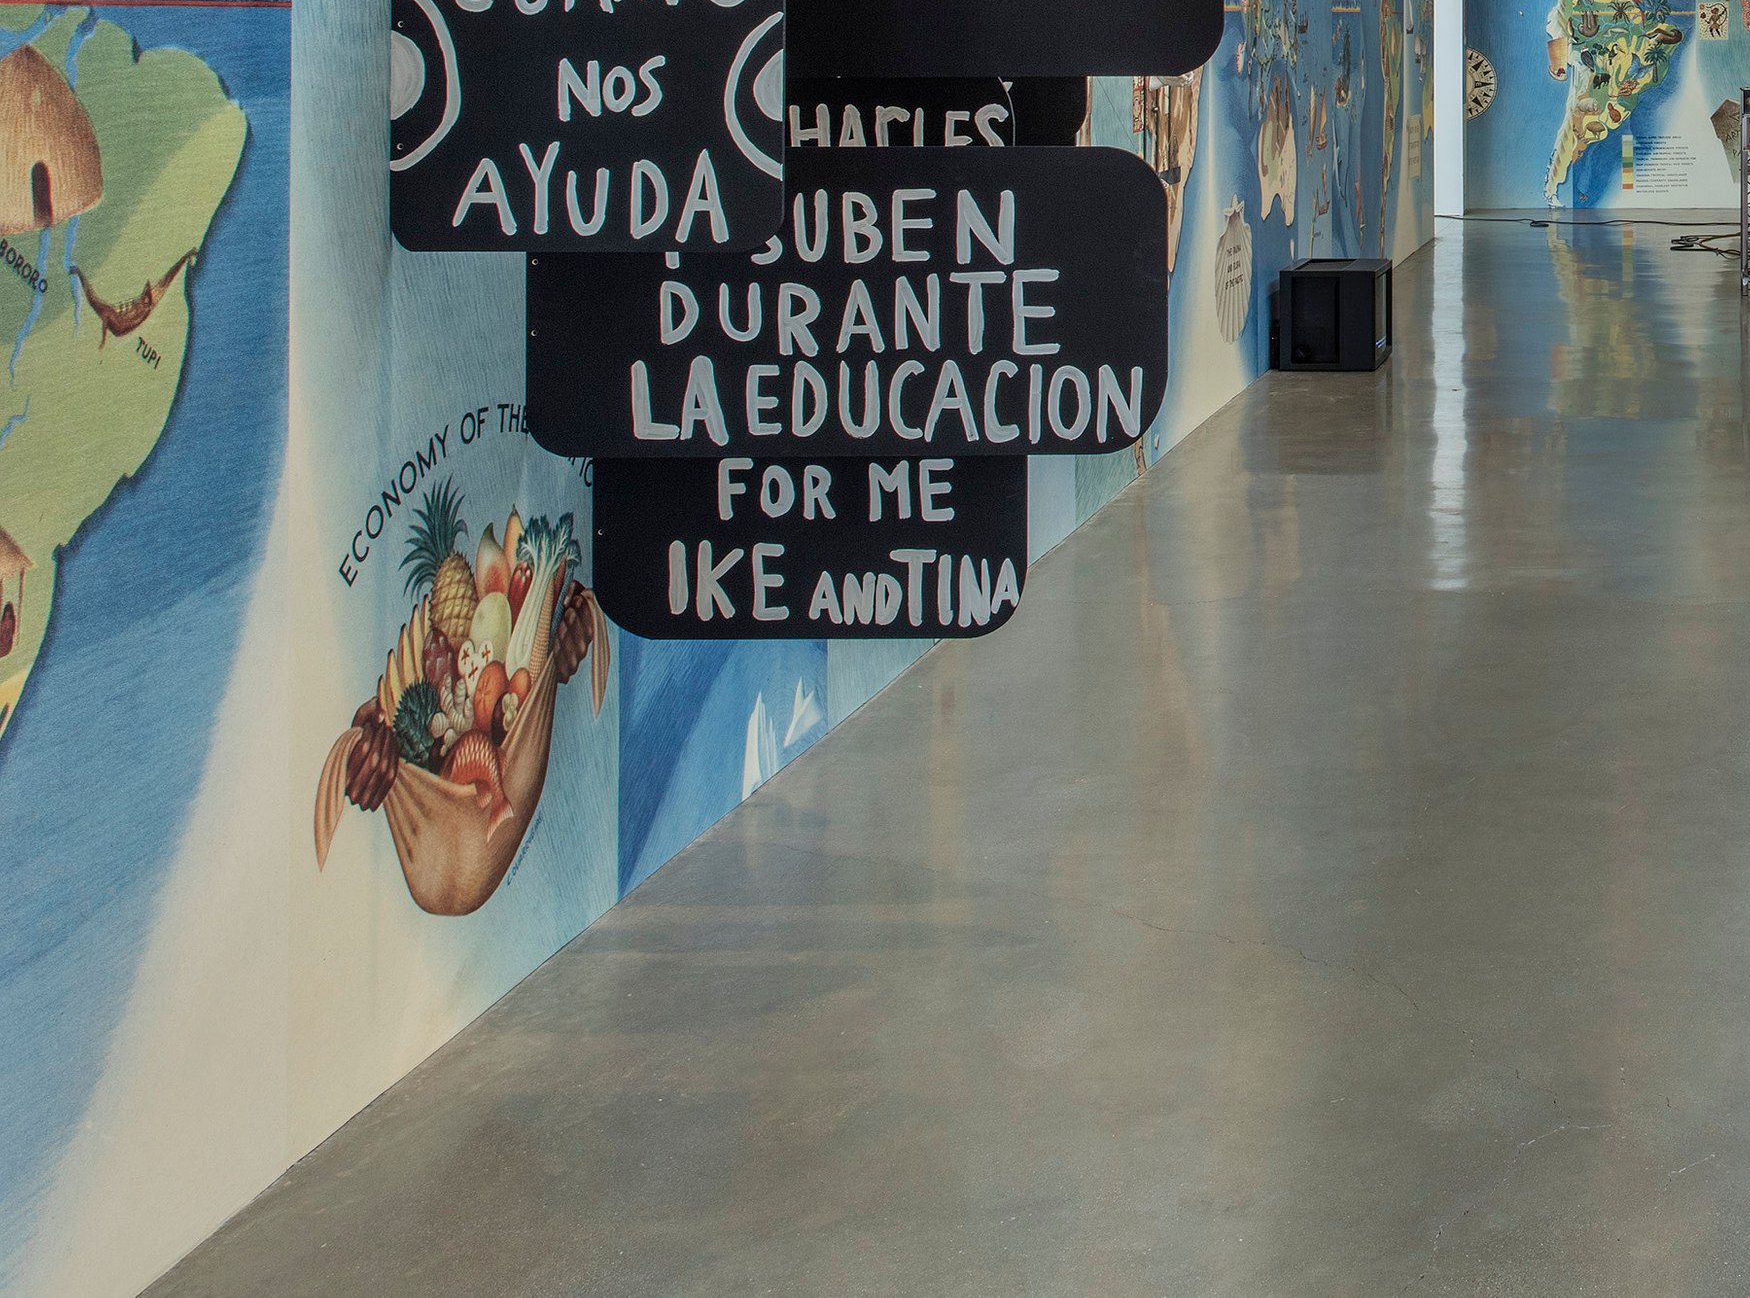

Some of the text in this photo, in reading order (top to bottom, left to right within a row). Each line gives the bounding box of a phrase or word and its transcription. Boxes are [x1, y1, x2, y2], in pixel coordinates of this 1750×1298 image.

[557, 54, 666, 123] NOS
[452, 140, 730, 244] AYUDA
[0, 238, 48, 294] BORORO
[136, 336, 162, 370] TUPI
[659, 269, 1062, 358] DURANTE
[630, 354, 1144, 447] LA EDUCACION
[338, 403, 530, 588] ECONOMY OF THE
[717, 458, 955, 523] FOR ME
[668, 539, 790, 622] IKE
